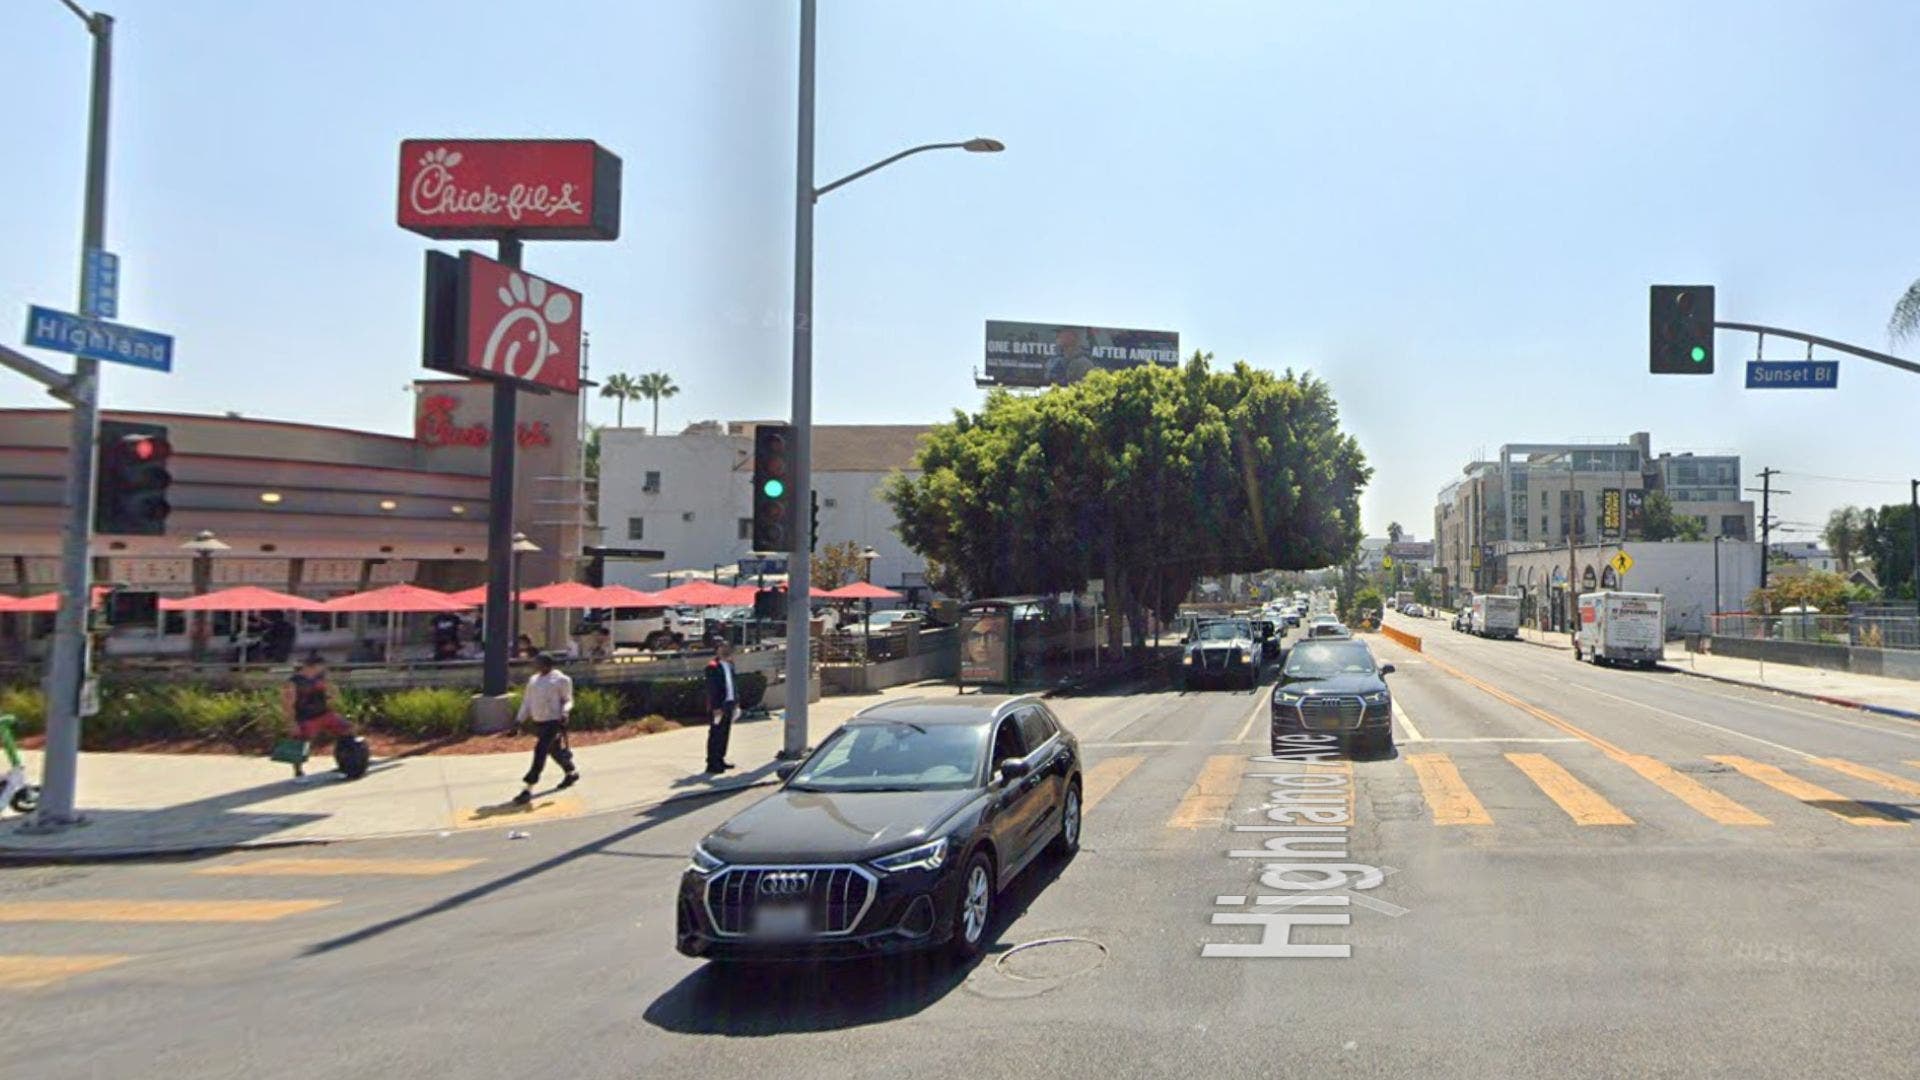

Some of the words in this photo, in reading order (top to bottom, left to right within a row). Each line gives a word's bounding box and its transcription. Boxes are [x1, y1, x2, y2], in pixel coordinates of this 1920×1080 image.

[411, 162, 583, 220] Chick-fil-A
[36, 316, 165, 362] Highland
[987, 340, 1010, 353] ONE
[1013, 341, 1057, 355] BATTLE
[1092, 345, 1127, 359] AFTER
[1129, 348, 1179, 362] ANOTHER
[1754, 366, 1809, 382] Sunset
[1815, 366, 1832, 382] Bl
